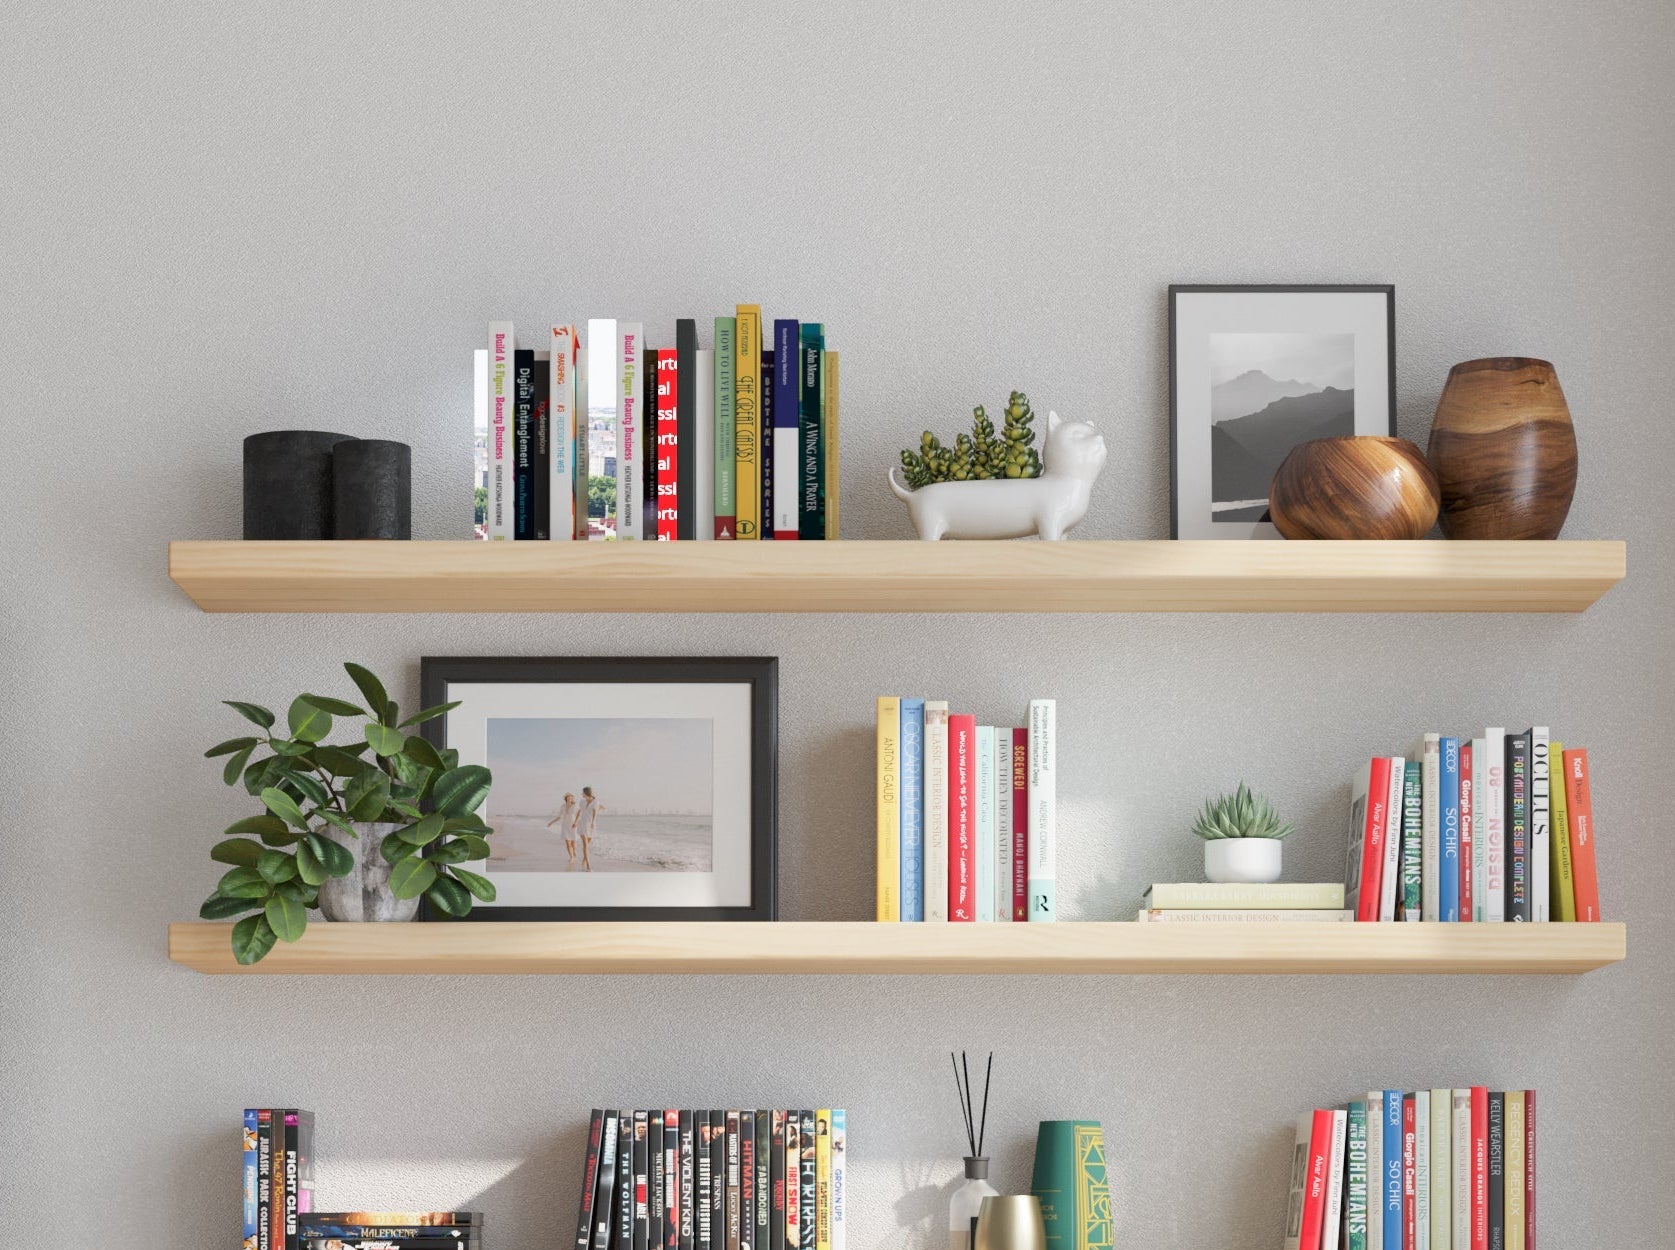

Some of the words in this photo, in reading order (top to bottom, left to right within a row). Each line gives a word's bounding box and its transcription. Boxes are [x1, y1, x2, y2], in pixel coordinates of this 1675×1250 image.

[494, 334, 505, 354] Build
[624, 334, 634, 354] Build
[720, 330, 730, 352] HOW
[720, 355, 730, 368] TO
[806, 348, 818, 364] John
[492, 370, 505, 395] Figure
[516, 367, 530, 399] Digital
[622, 372, 634, 396] Figure
[720, 371, 730, 392] LIVE
[736, 376, 754, 394] THE
[492, 397, 505, 425] Beauty
[622, 398, 634, 425] Beauty
[720, 394, 730, 419] WELL
[736, 398, 754, 427] GREAT
[764, 376, 772, 446] BEDTIME
[494, 426, 505, 460] Business
[516, 404, 530, 468] Entanglement
[624, 427, 634, 460] Business
[736, 430, 754, 464] GATSBY
[806, 430, 818, 454] WING
[806, 455, 817, 474] AND
[764, 458, 772, 528] STORIES
[806, 482, 818, 512] PRAYER
[882, 737, 894, 772] ANTONI
[904, 722, 920, 775] OSCAR
[999, 738, 1008, 763] HOW
[999, 768, 1008, 795] THEY
[1032, 769, 1040, 787] Design
[1574, 757, 1584, 778] Knoll
[1392, 766, 1402, 815] Watercolors
[1460, 780, 1471, 814] Giorgio
[1514, 756, 1524, 817] POSTMODERN
[1533, 744, 1548, 835] OCULUS
[1575, 779, 1583, 804] Design
[904, 776, 920, 846] NIEMEYER
[1040, 800, 1048, 829] ANDREW
[1374, 802, 1382, 822] Alvar
[1390, 816, 1398, 826] by
[1446, 808, 1456, 826] SO
[932, 814, 942, 848] DESIGN
[999, 799, 1008, 865] DECORATED
[1371, 824, 1380, 844] Aalto
[1390, 828, 1398, 844] Finn
[1405, 797, 1422, 884] BOHEMIANS
[1462, 814, 1472, 842] Casali
[1475, 812, 1484, 868] INTERIORS
[1514, 820, 1524, 854] DESIGN
[1556, 810, 1567, 845] Japanese
[1446, 828, 1456, 858] CHIC
[1488, 818, 1502, 890] DESIGN
[1561, 846, 1570, 880] Gardens
[1514, 856, 1524, 904] COMPLETE
[1246, 914, 1280, 922] DESIGN
[1490, 1098, 1500, 1123] KELLY
[604, 1118, 617, 1165] INSOMNIA
[682, 1130, 692, 1154] THE
[729, 1133, 738, 1155] MASTERS
[1334, 1118, 1344, 1168] Watercolors
[1350, 1122, 1358, 1138] NEW
[1358, 1126, 1366, 1138] THE
[1510, 1102, 1521, 1167] REGENCY
[259, 1136, 270, 1176] JURASSIC
[275, 1149, 284, 1170] The
[622, 1152, 630, 1175] THE
[729, 1156, 738, 1164] OF
[1404, 1132, 1414, 1166] Giorgio
[1490, 1125, 1500, 1176] WEARSTLER
[274, 1170, 283, 1184] 47
[286, 1150, 296, 1194] FIGHT
[744, 1140, 752, 1198] HITMAN
[788, 1166, 798, 1186] FIRST
[1314, 1154, 1324, 1174] Alvar
[1332, 1170, 1340, 1180] by
[1389, 1160, 1400, 1179] SO
[259, 1178, 270, 1202] PARK
[682, 1156, 692, 1208] VIOLENT
[714, 1174, 722, 1210] TRESPASS
[1312, 1176, 1321, 1198] Aalto
[1350, 1140, 1366, 1233] BOHEMIANS
[1389, 1180, 1400, 1210] CHIC
[1406, 1168, 1414, 1196] Casali
[1418, 1164, 1428, 1221] INTERIORS
[1510, 1170, 1521, 1216] REDUX
[274, 1185, 284, 1212] Ronin
[622, 1182, 630, 1238] WOLFMAN
[758, 1172, 767, 1226] ABANDONED
[788, 1188, 798, 1226] SNOW
[286, 1194, 296, 1235] CLUB
[682, 1208, 692, 1236] KIND
[700, 1198, 710, 1242] PRISONERS
[361, 1228, 416, 1238] MALEFICENT
